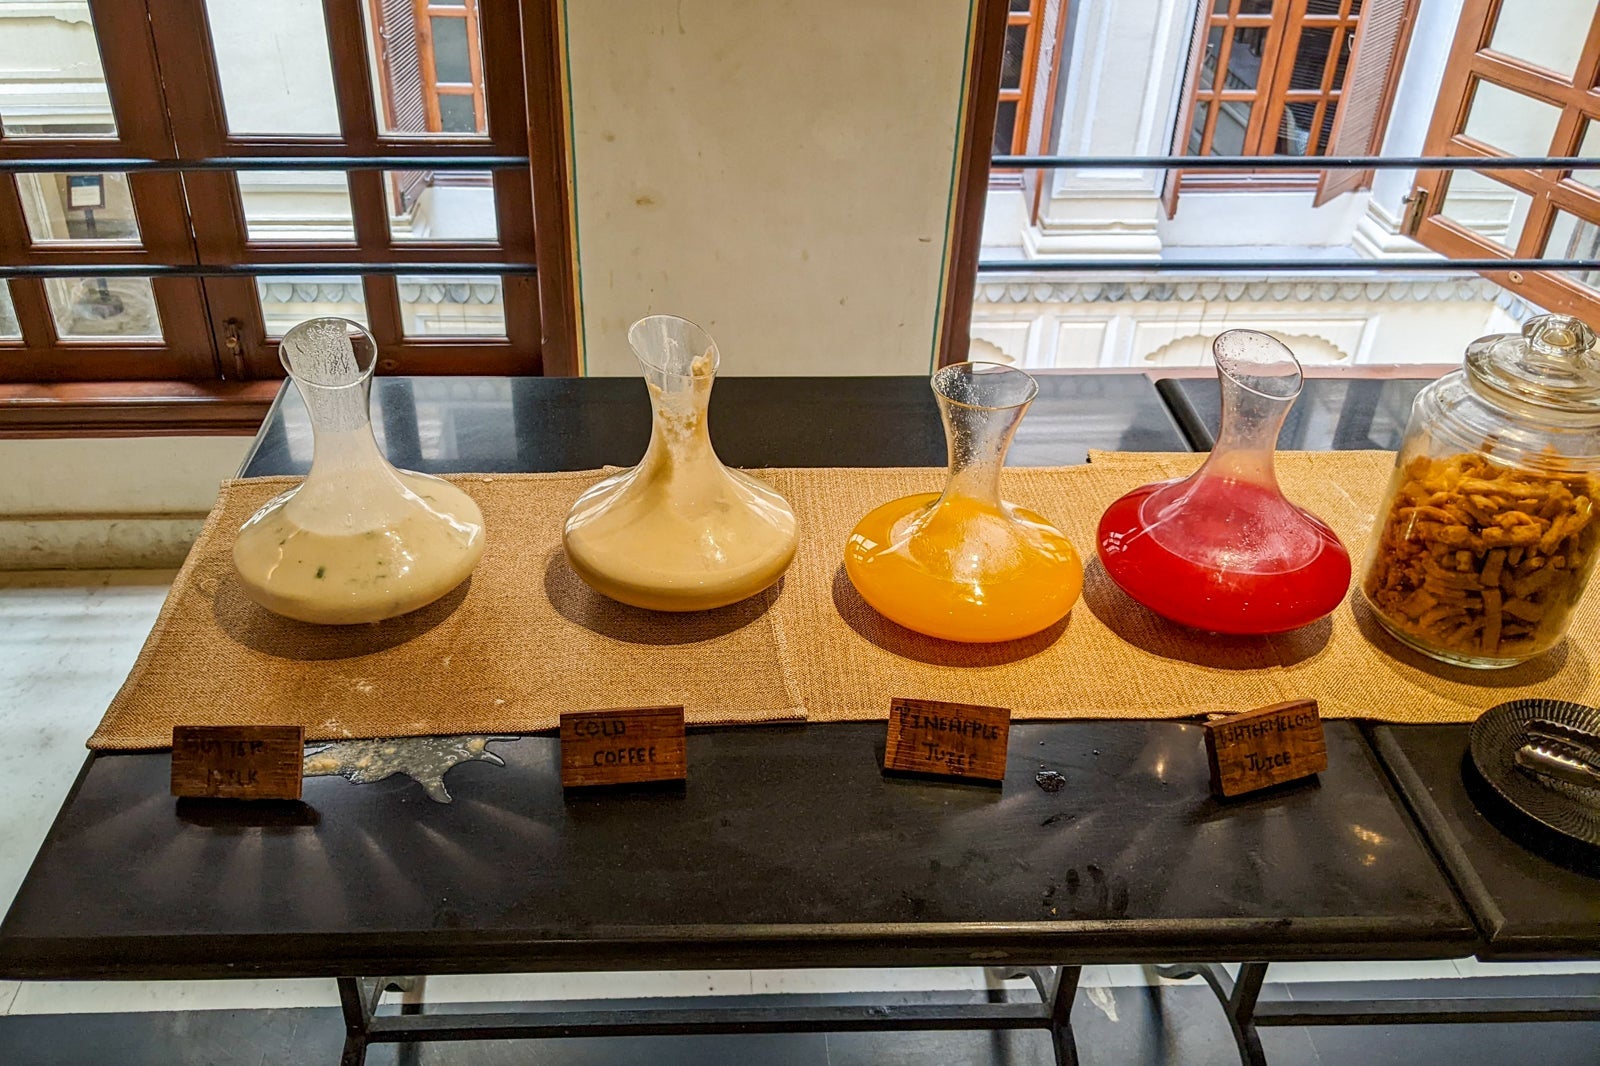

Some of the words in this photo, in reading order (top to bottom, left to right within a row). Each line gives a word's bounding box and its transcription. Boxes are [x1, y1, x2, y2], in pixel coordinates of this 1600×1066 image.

[574, 720, 626, 736] COLD
[895, 703, 1000, 740] PINEAPPLE
[593, 746, 656, 767] COFFEE
[1244, 751, 1291, 772] JUICE
